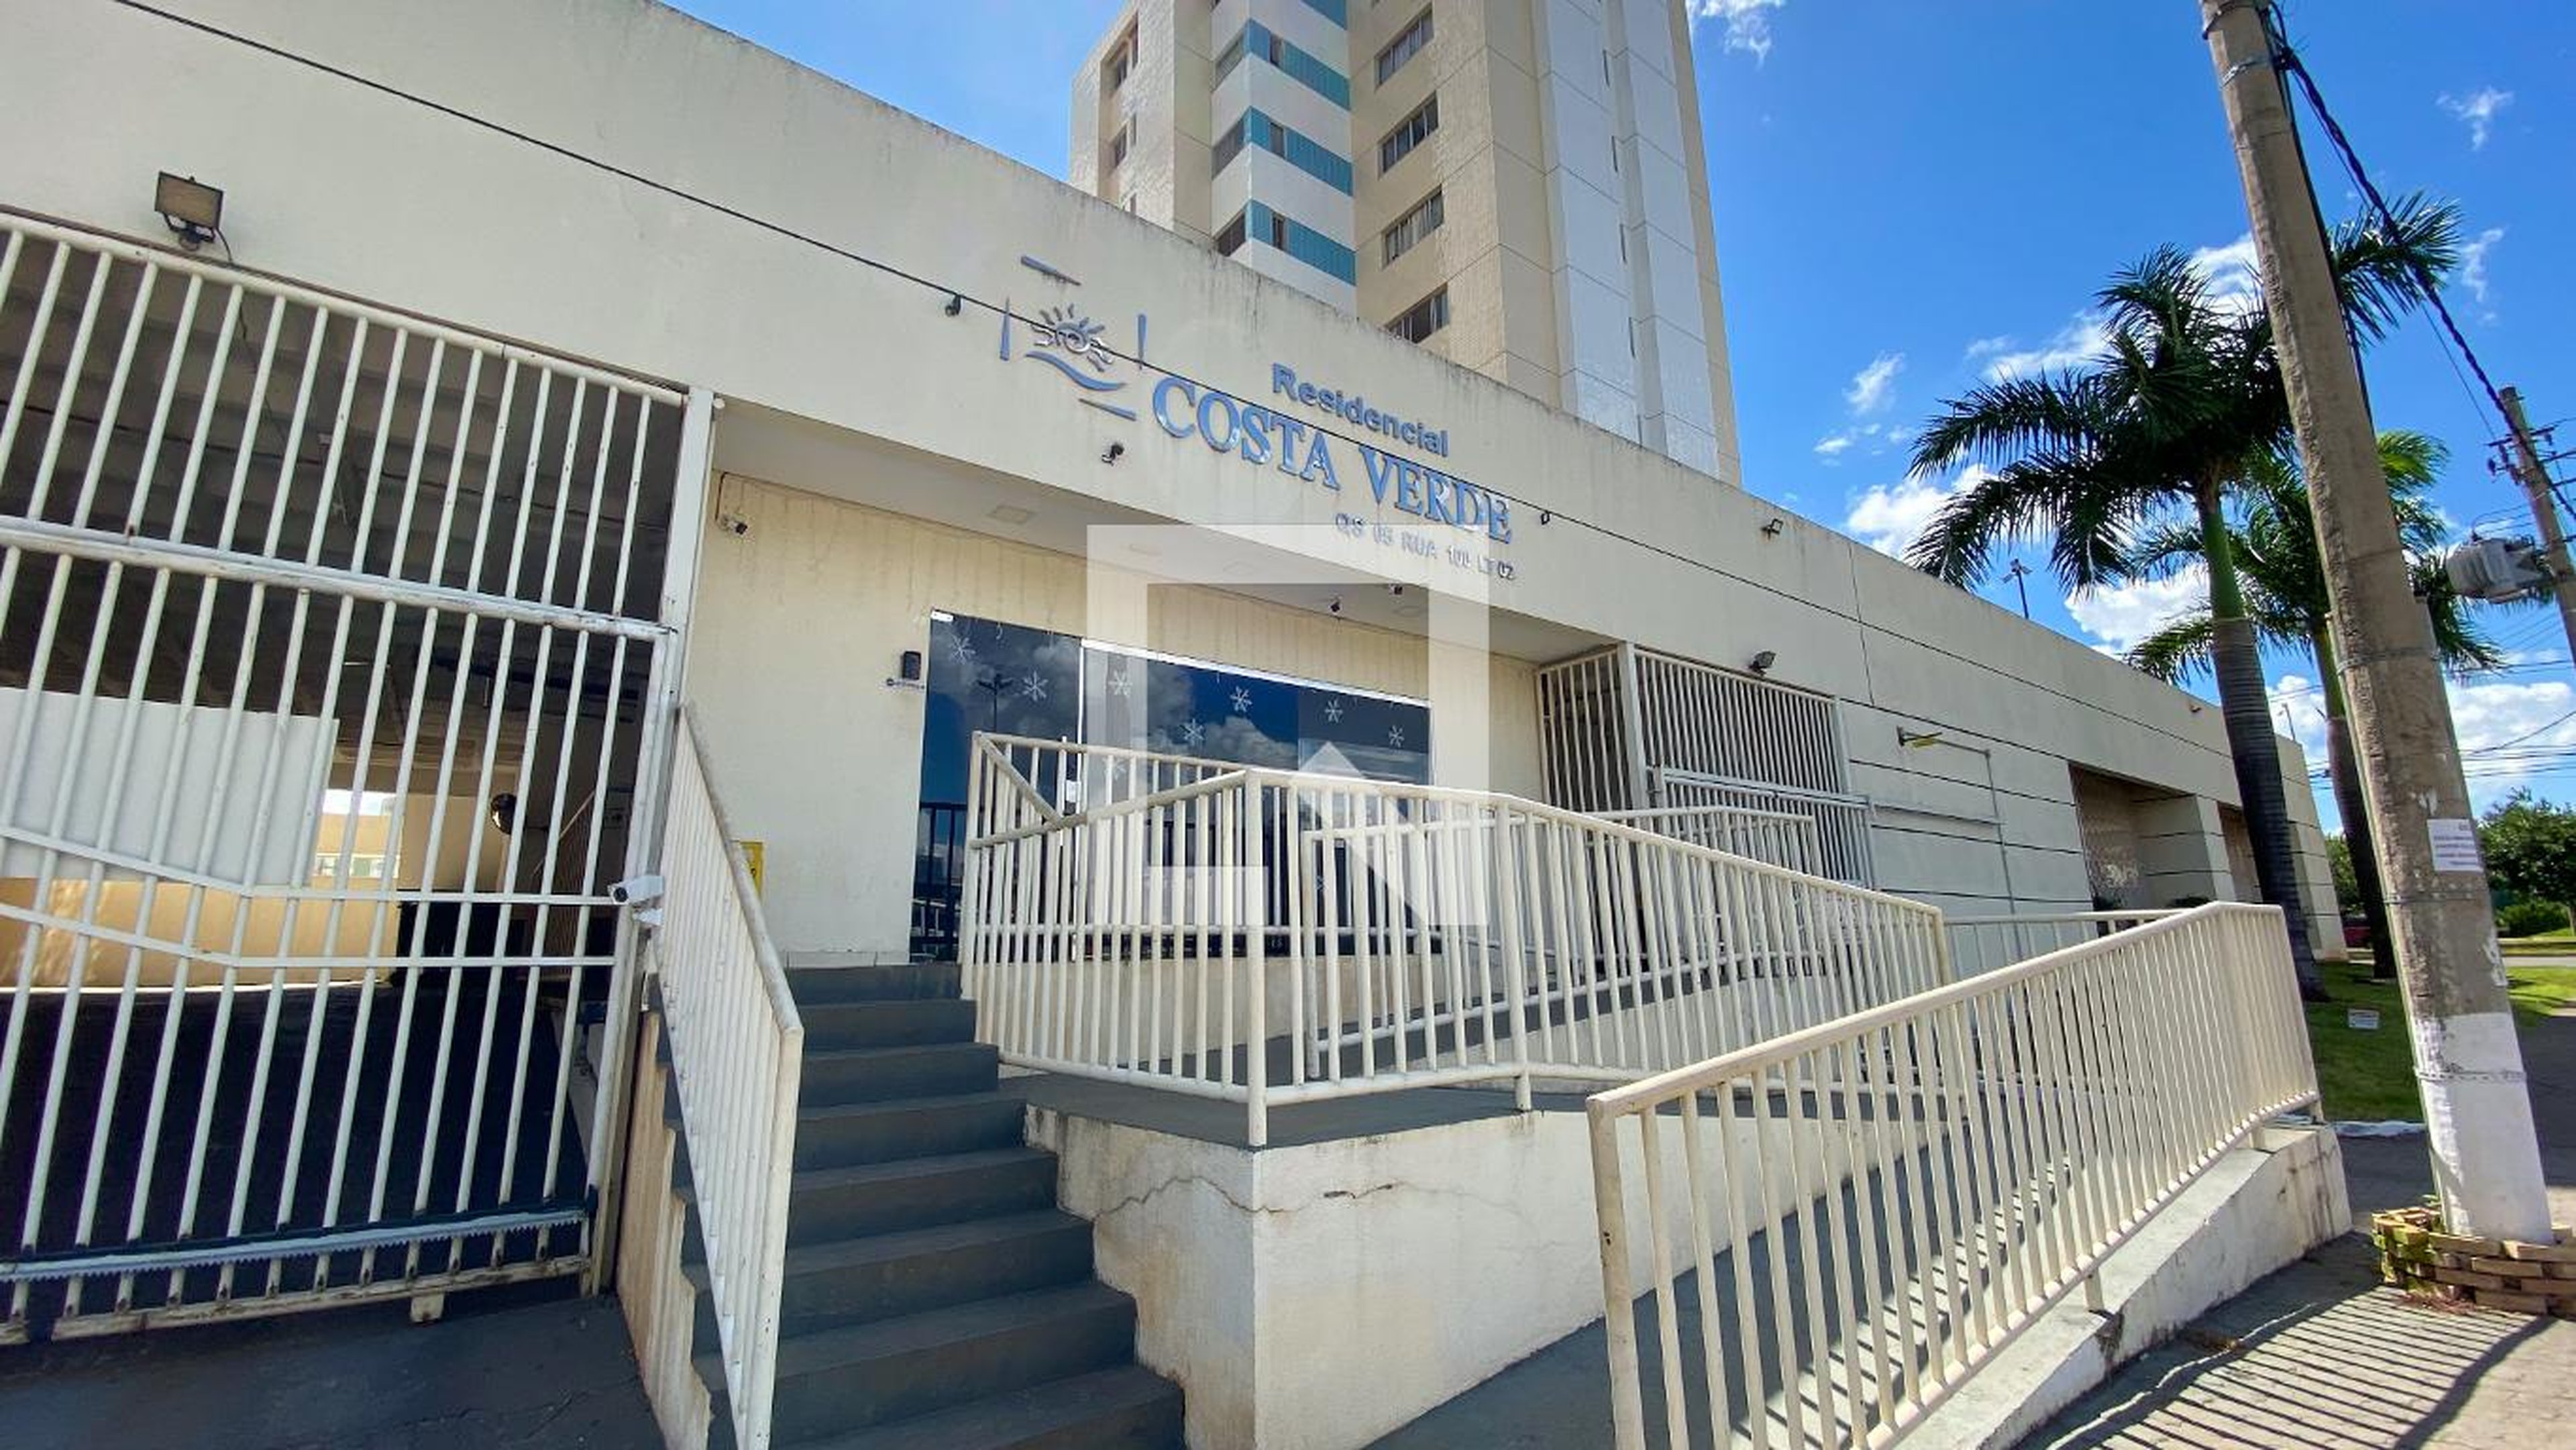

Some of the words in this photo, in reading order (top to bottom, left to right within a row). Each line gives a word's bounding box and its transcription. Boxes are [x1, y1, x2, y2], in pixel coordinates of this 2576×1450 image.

[1273, 362, 1448, 457] Residencial
[1152, 376, 1340, 491] COSTA
[1359, 444, 1512, 544] VERDE
[1401, 531, 1438, 560] RUA
